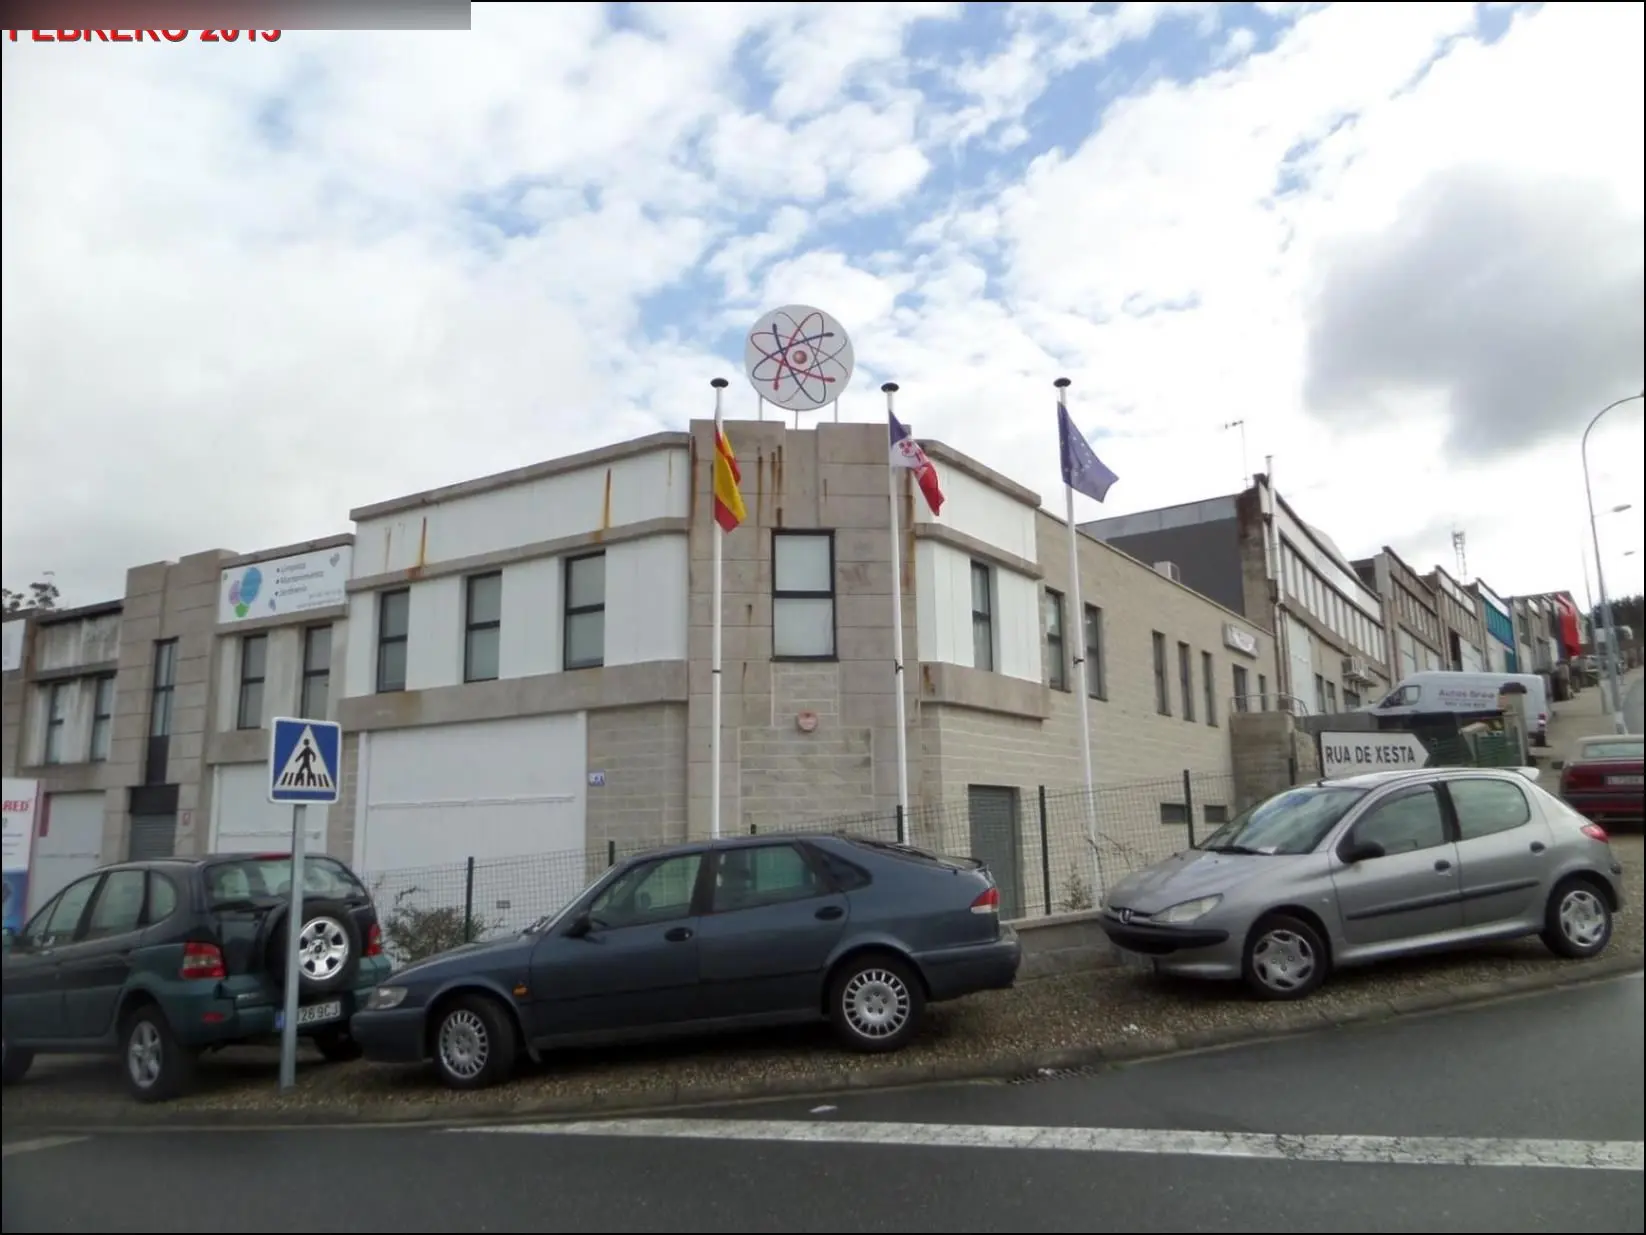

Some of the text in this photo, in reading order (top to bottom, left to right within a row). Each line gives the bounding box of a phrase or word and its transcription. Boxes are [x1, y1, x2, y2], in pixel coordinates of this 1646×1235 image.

[1325, 745, 1416, 764] RUA DE XESTA
